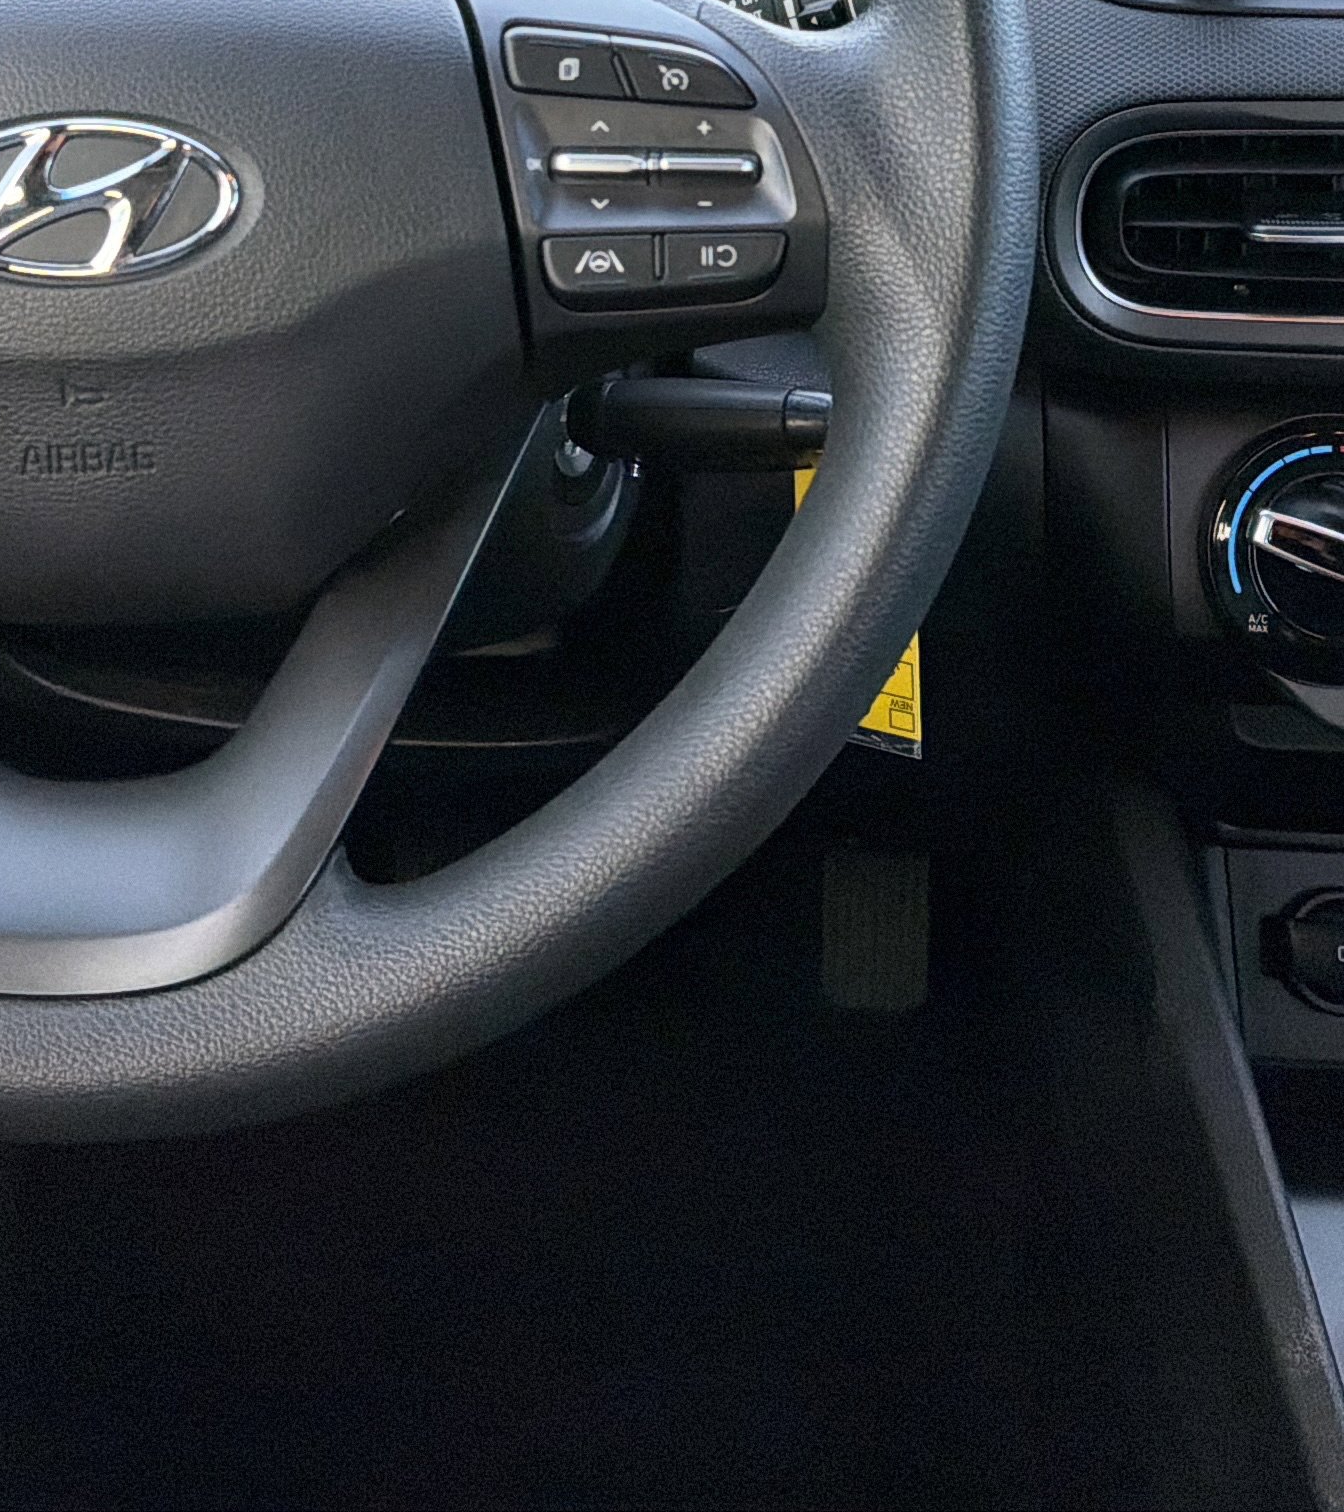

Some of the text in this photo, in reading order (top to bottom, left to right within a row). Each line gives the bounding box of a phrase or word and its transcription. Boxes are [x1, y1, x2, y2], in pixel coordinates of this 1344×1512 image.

[1248, 613, 1269, 625] A/C
[1248, 625, 1269, 634] MAX
[889, 698, 914, 711] NEW
